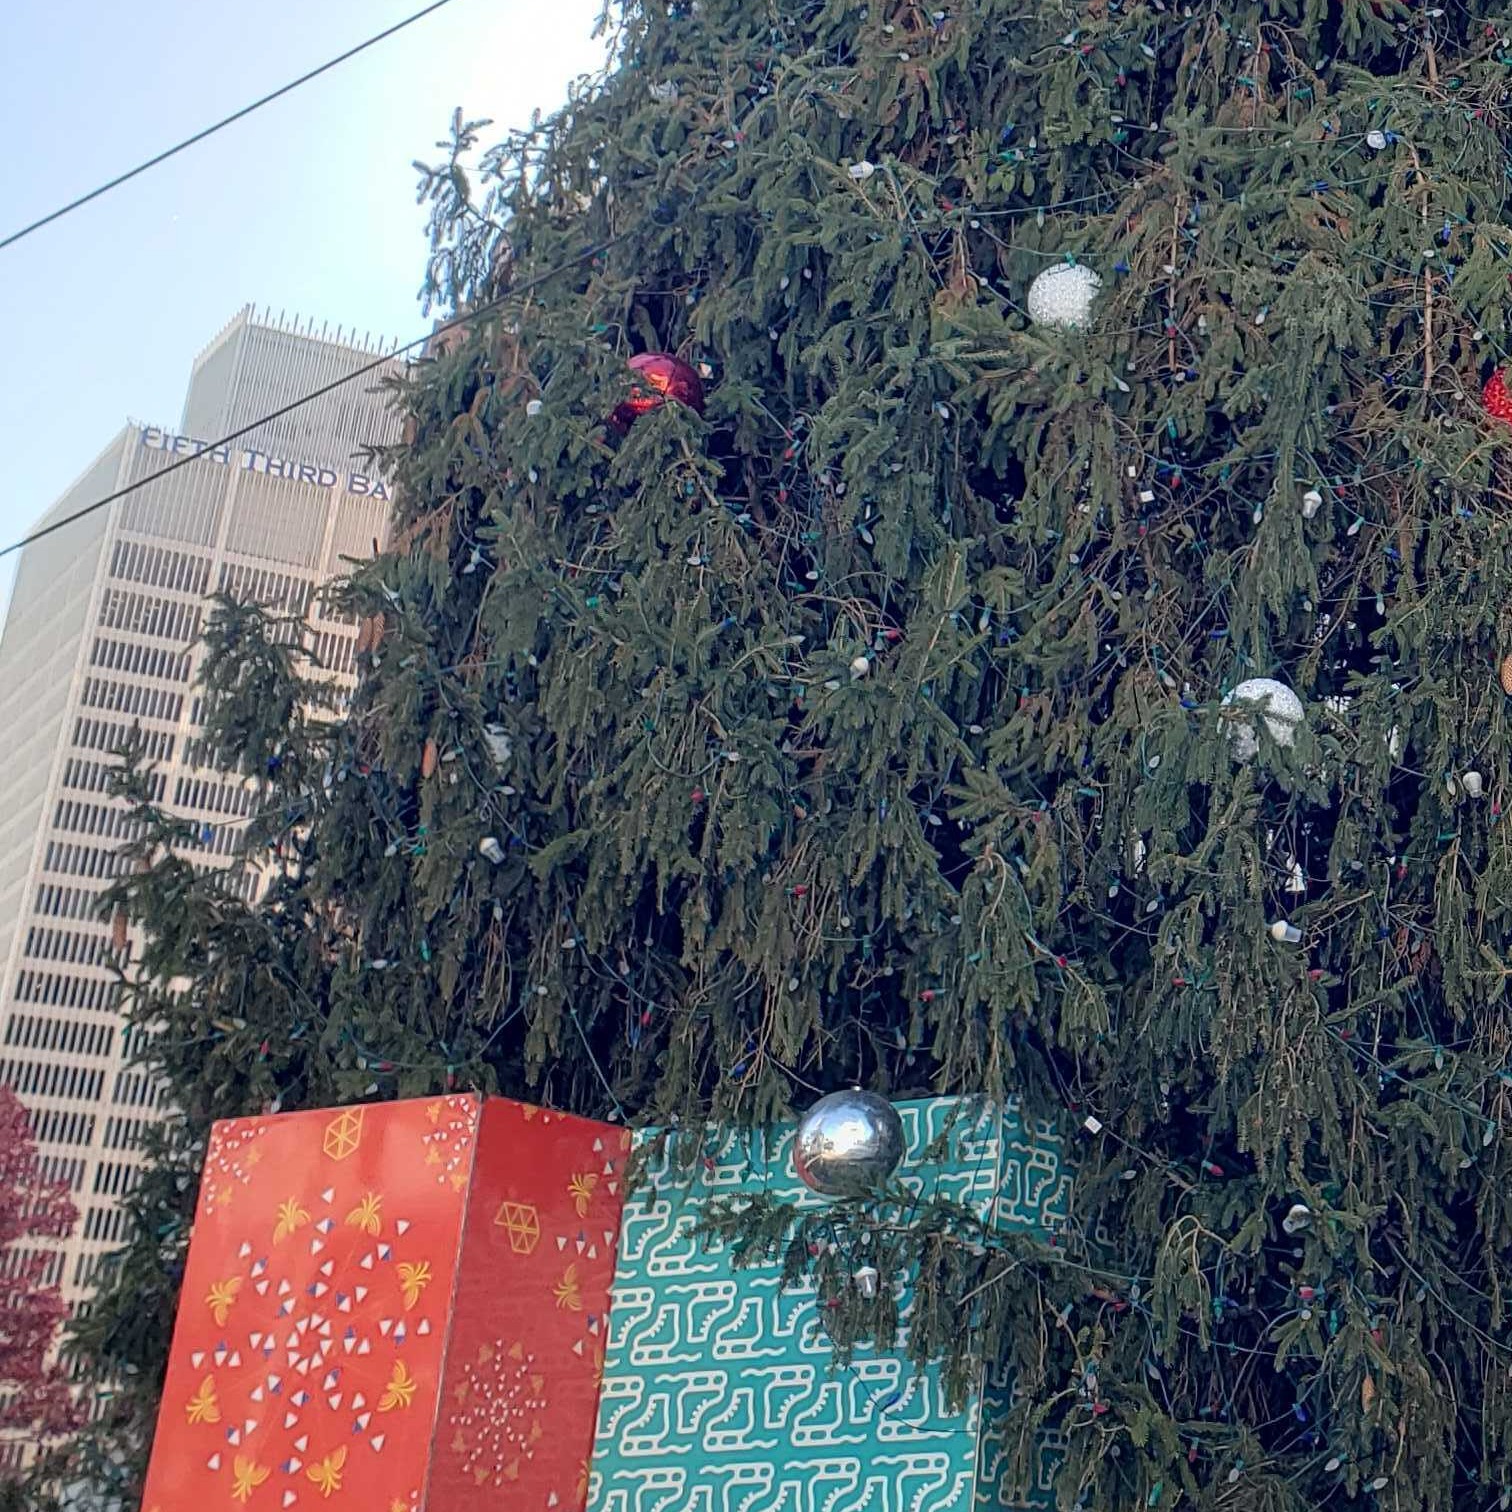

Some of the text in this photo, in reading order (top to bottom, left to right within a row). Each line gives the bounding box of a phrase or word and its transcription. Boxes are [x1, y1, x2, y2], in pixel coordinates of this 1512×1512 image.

[141, 426, 390, 501] FIFTH THIRD BA
